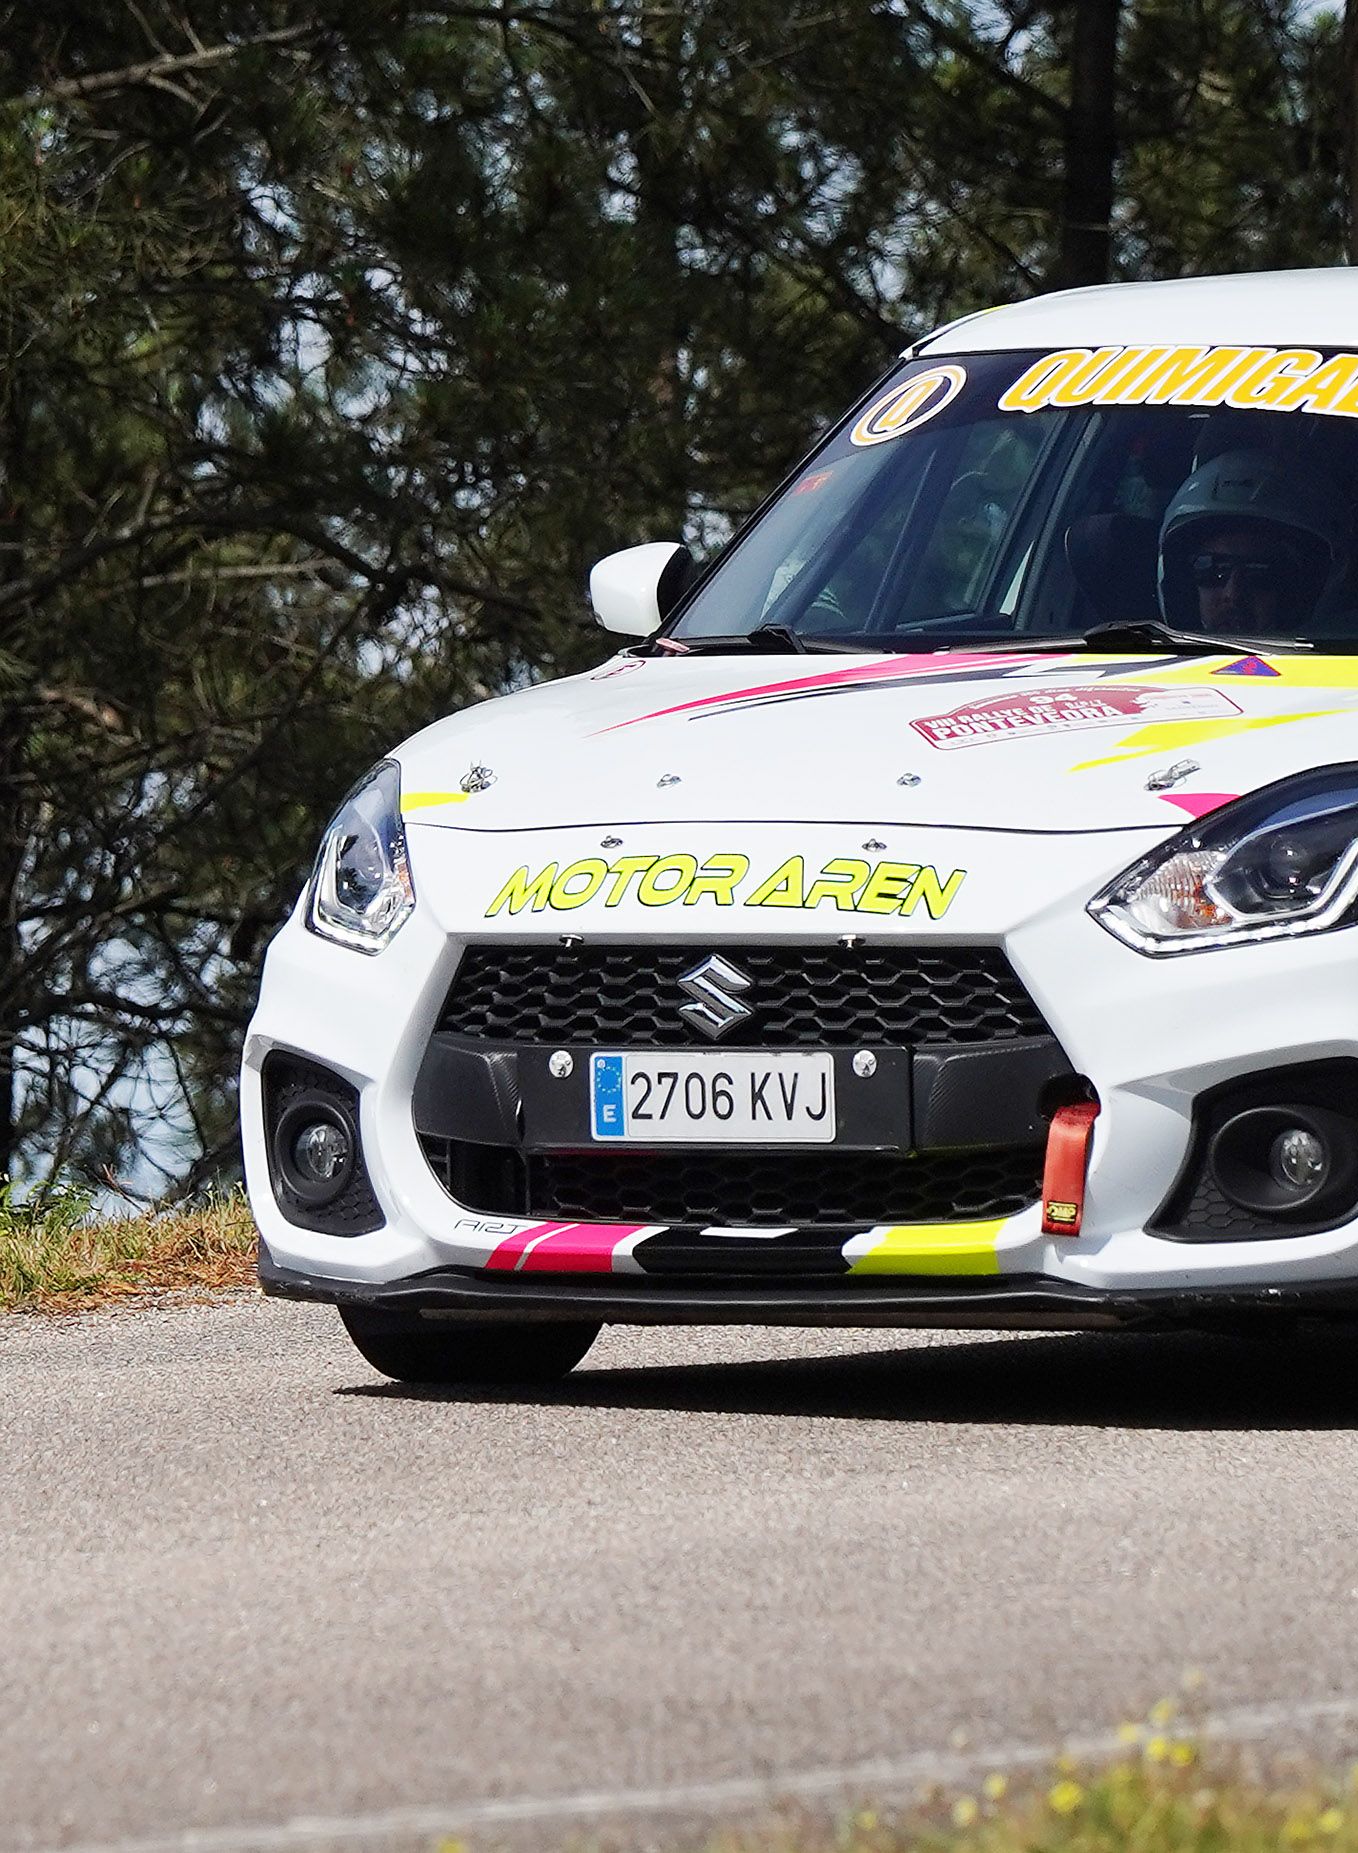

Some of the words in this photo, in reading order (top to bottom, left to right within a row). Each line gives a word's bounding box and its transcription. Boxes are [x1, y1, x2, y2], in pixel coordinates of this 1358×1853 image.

[932, 706, 1124, 740] PONTEVEDRA
[957, 707, 1028, 724] RALLYE
[1028, 704, 1057, 715] DE
[485, 853, 750, 918] MOTOR
[744, 855, 968, 920] AREN
[630, 1072, 735, 1121] 2706
[750, 1072, 829, 1121] KVJ
[603, 1104, 618, 1124] E
